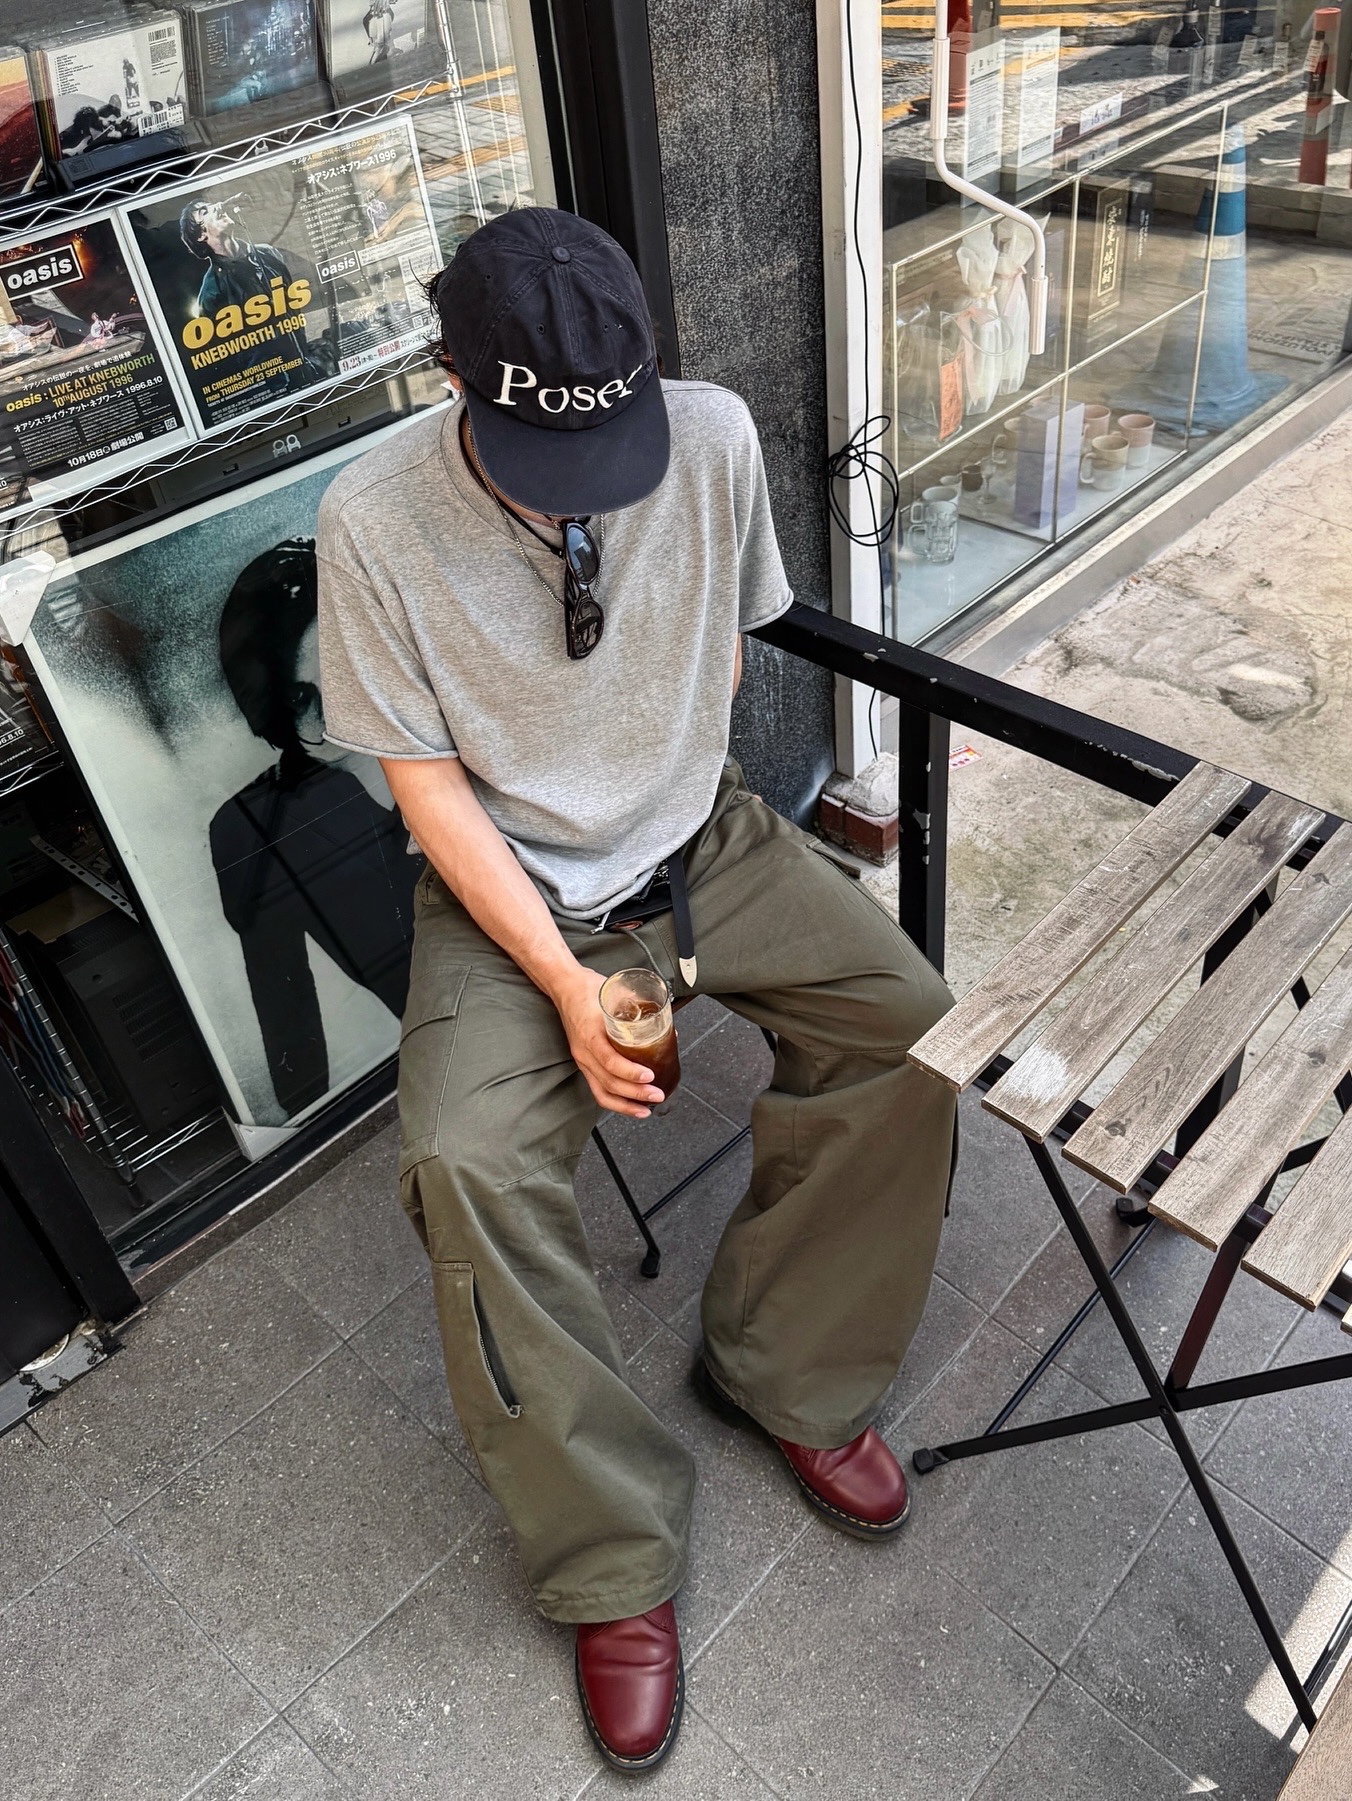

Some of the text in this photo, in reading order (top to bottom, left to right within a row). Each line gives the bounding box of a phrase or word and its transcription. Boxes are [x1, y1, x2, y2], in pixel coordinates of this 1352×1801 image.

[7, 257, 73, 289] oasis
[321, 257, 356, 277] oasis
[182, 276, 312, 349] oasis
[191, 325, 276, 370] KNEBWORTH
[276, 313, 307, 336] 1996
[6, 393, 42, 412] oasis
[48, 381, 73, 398] LIVE
[74, 376, 88, 391] AT
[88, 353, 156, 385] KNEBWORTH
[202, 386, 211, 395] IN
[211, 372, 242, 391] CINEMAS
[242, 356, 283, 378] WORLDWIDE
[205, 393, 220, 403] FROM
[220, 377, 255, 396] THURSDAY
[255, 373, 265, 382] 23
[265, 358, 303, 378] SEPTEMBER
[342, 355, 361, 372] 9.23
[70, 382, 108, 403] AUGUST
[109, 374, 134, 389] 1996
[125, 375, 163, 394] 1996.8.10
[493, 360, 642, 413] Poser
